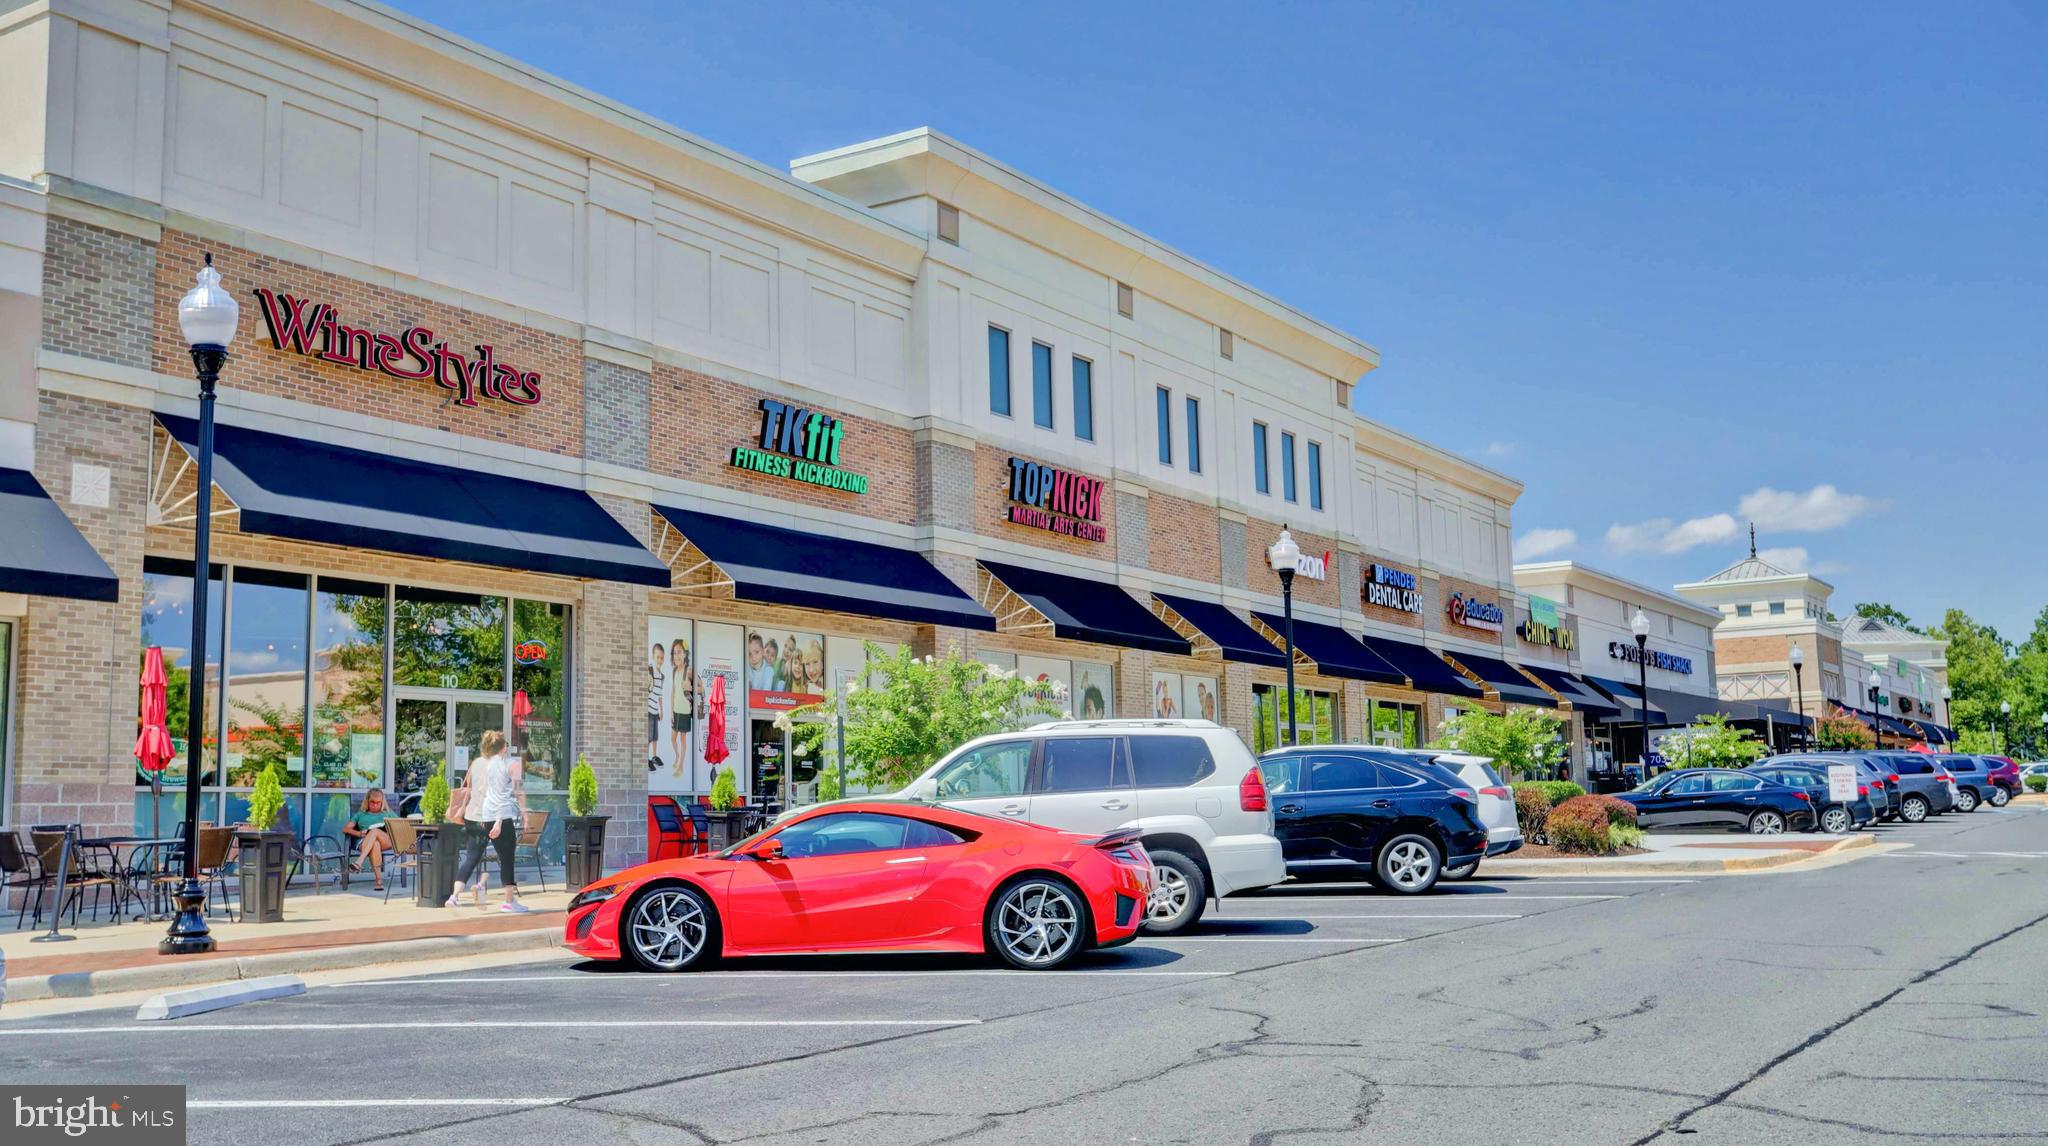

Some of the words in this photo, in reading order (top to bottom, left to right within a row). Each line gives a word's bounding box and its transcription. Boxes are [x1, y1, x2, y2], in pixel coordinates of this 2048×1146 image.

[254, 288, 542, 407] WineStyles
[733, 447, 792, 477] FITNESS
[793, 461, 868, 494] KICKBOXING
[1010, 457, 1104, 521] TOPKICK
[1011, 506, 1050, 530] MARTIAL
[1053, 516, 1074, 535] ARTS
[1077, 522, 1106, 542] CENTER
[1383, 567, 1415, 590] PENDER
[1368, 582, 1402, 608] DENTAL
[1402, 591, 1424, 614] CARE
[1466, 599, 1504, 624] education
[1524, 619, 1551, 646] CHINA
[1555, 627, 1574, 651] WOK
[515, 643, 546, 660] OPEN
[440, 674, 459, 688] 110
